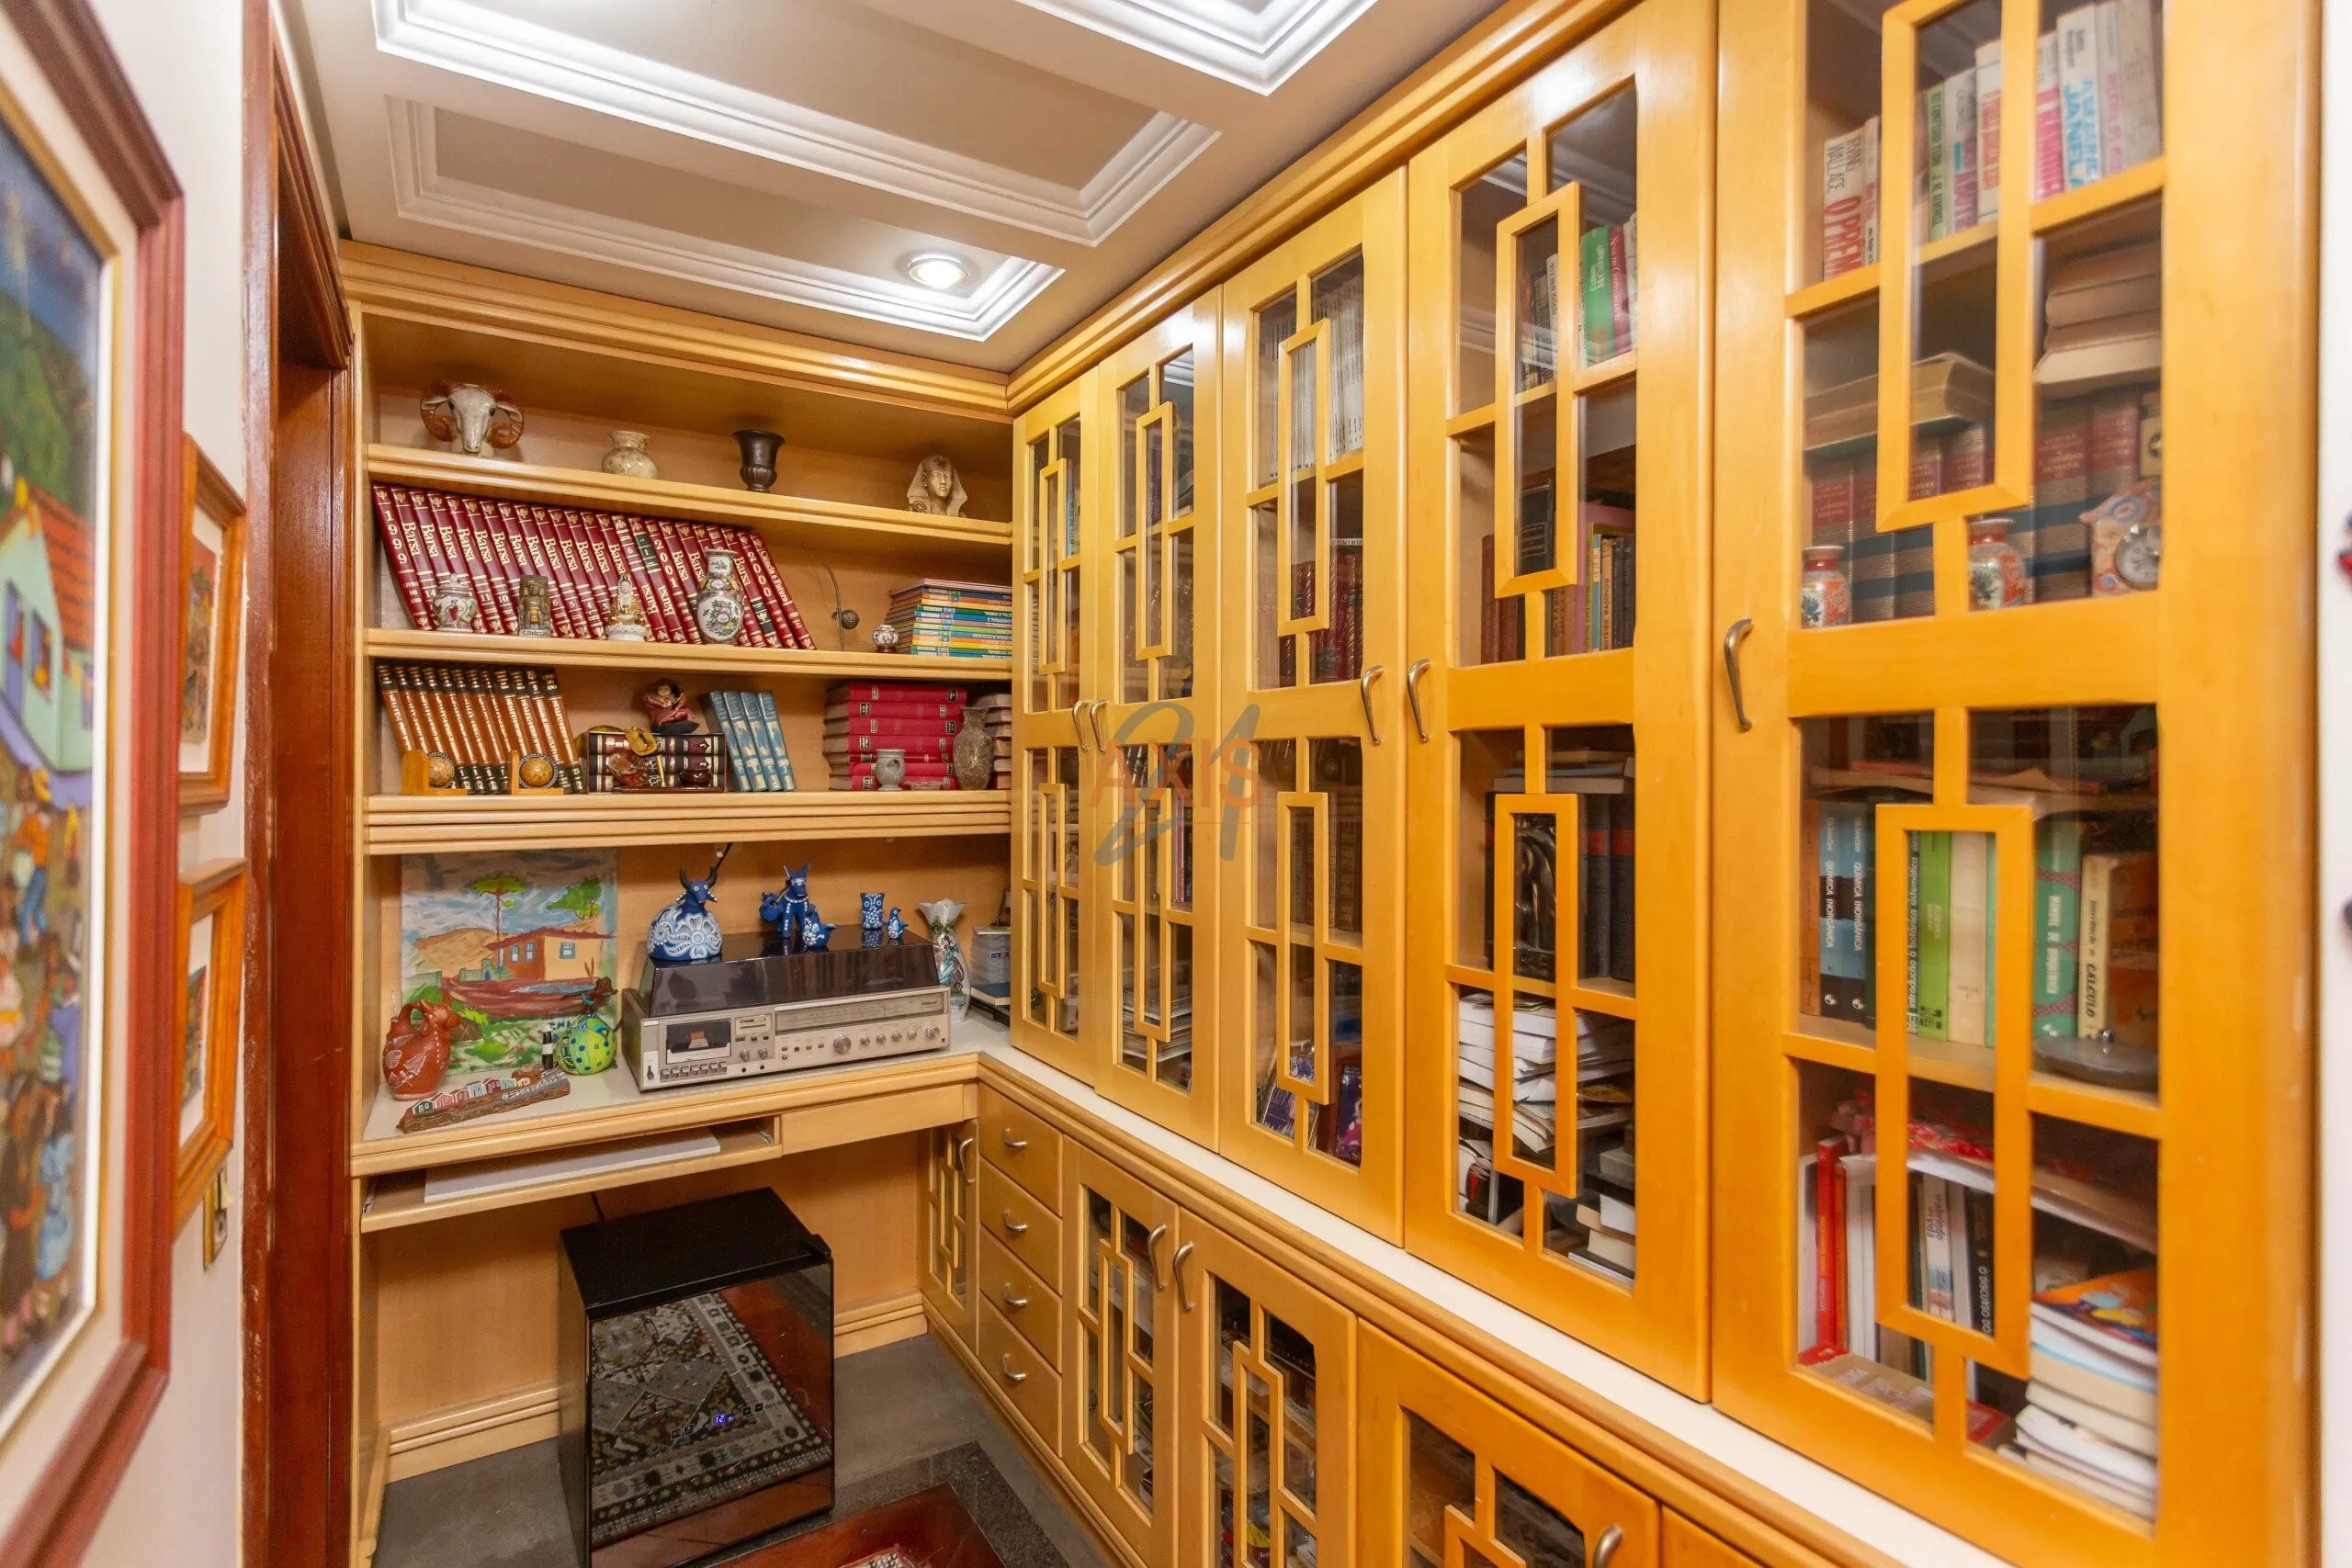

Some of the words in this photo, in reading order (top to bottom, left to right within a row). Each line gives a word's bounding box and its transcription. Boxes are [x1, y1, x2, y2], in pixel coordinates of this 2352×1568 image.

[1827, 143, 1845, 194] WALLACE
[1846, 135, 1862, 172] IRVING
[385, 511, 407, 564] 1999
[401, 522, 420, 556] Barsa
[421, 524, 438, 558] Barsa
[439, 525, 457, 558] Barsa
[458, 528, 475, 561] Barsa
[474, 530, 492, 563] Barsa
[492, 532, 510, 565] Barsa
[509, 534, 526, 566] Barsa
[526, 536, 544, 568] Barsa
[543, 537, 561, 570] Barsa
[560, 539, 578, 572] Barsa
[577, 541, 594, 572] Barsa
[593, 542, 609, 573] Barsa
[608, 545, 626, 573] Barsa
[654, 539, 679, 588] 2001
[672, 551, 689, 581] Barsa
[688, 551, 706, 582] Barsa
[733, 557, 751, 586] Barsa
[747, 551, 772, 597] 2000
[760, 550, 775, 575] Ciência
[774, 578, 788, 602] Futuro
[425, 589, 436, 597] 14
[641, 583, 659, 615] Barsa
[658, 585, 674, 615] Barsa
[1910, 856, 1918, 906] sistemática
[1825, 898, 1835, 947] INORGÂNICA
[1853, 900, 1863, 952] INORGÂNICA
[2049, 895, 2060, 926] MANUAL
[2047, 931, 2060, 942] DE
[1979, 1276, 1990, 1316] DISCURSO
